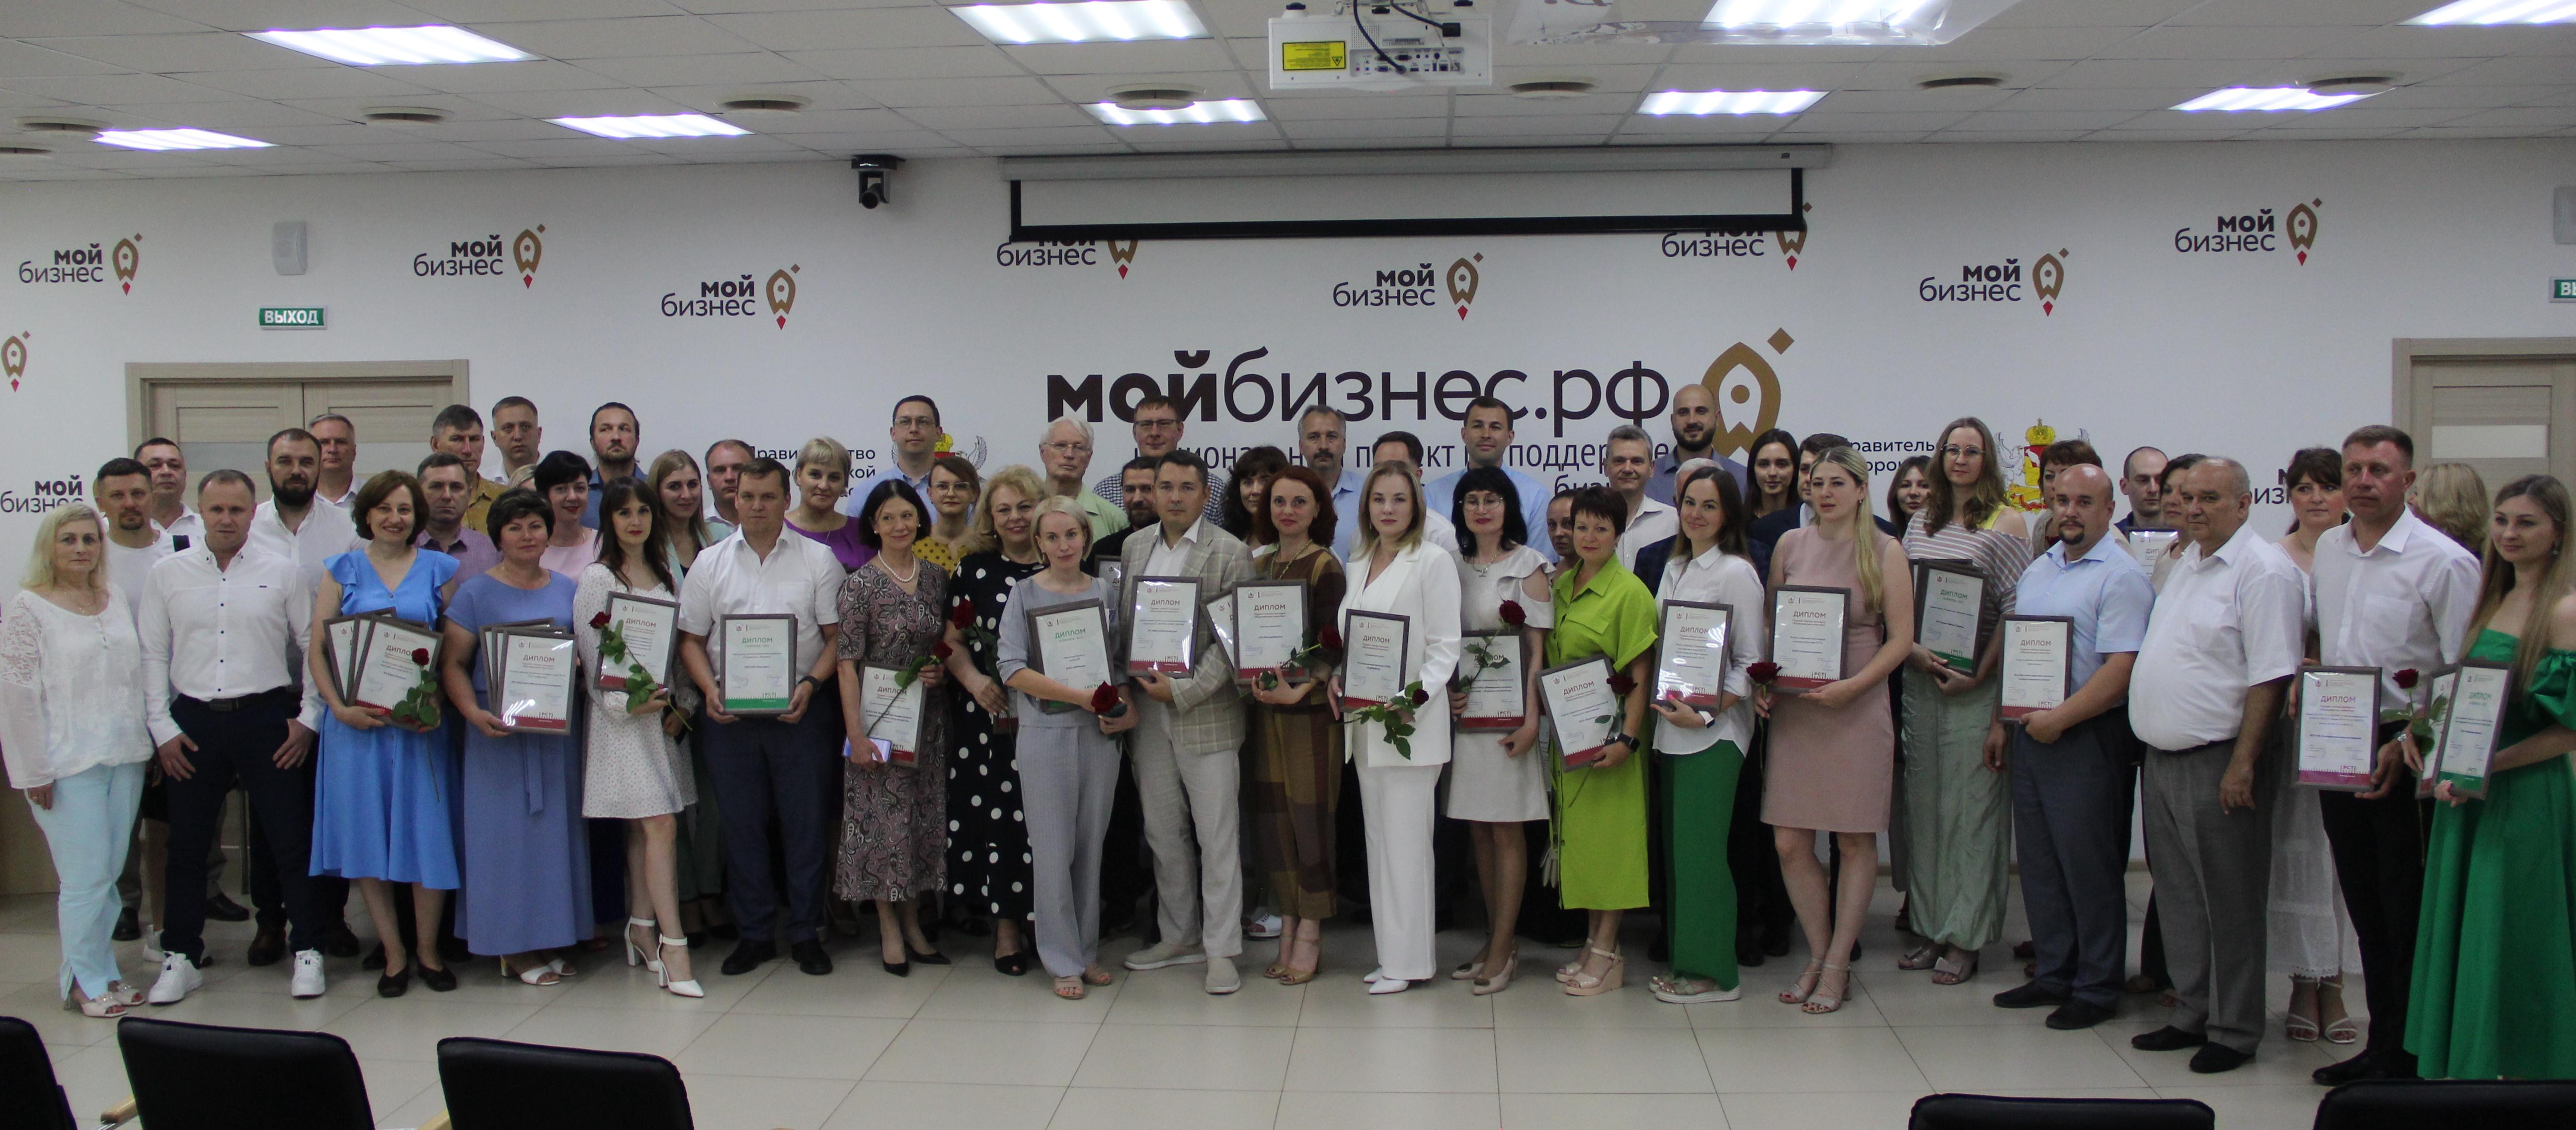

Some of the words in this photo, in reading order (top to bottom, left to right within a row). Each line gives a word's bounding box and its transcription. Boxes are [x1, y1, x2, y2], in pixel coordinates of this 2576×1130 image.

[2217, 209, 2274, 232] мой
[451, 235, 502, 256] мой
[1662, 232, 1764, 257] бизнес
[2175, 228, 2275, 252] бизнес
[54, 244, 102, 265] мой
[414, 253, 503, 276] бизнес
[997, 242, 1096, 266] бизнес
[19, 262, 103, 283] бизнес
[1376, 263, 1435, 287] мой
[1963, 258, 2021, 281] мой
[701, 275, 755, 297] мой
[1333, 282, 1436, 306] бизнес
[1920, 277, 2021, 302] бизнес
[662, 293, 755, 317] бизнес
[265, 310, 319, 325] ВЫХОД
[1047, 346, 1669, 437] мойбизнес.рф
[1851, 441, 1934, 452] равитель
[1509, 443, 1669, 474] поддере
[35, 475, 82, 495] мой
[0, 490, 83, 513] бизн
[1940, 589, 1968, 599] ДИПЛОМ
[626, 618, 656, 627] ДИПЛОМ
[1055, 628, 1086, 639] ДИПЛОМ
[386, 645, 412, 656] ДИПЛО
[1363, 635, 1390, 644] ДИПЛОМ
[878, 686, 907, 695] ДИПЛОМ
[1563, 681, 1594, 695] ДИПЛОМ
